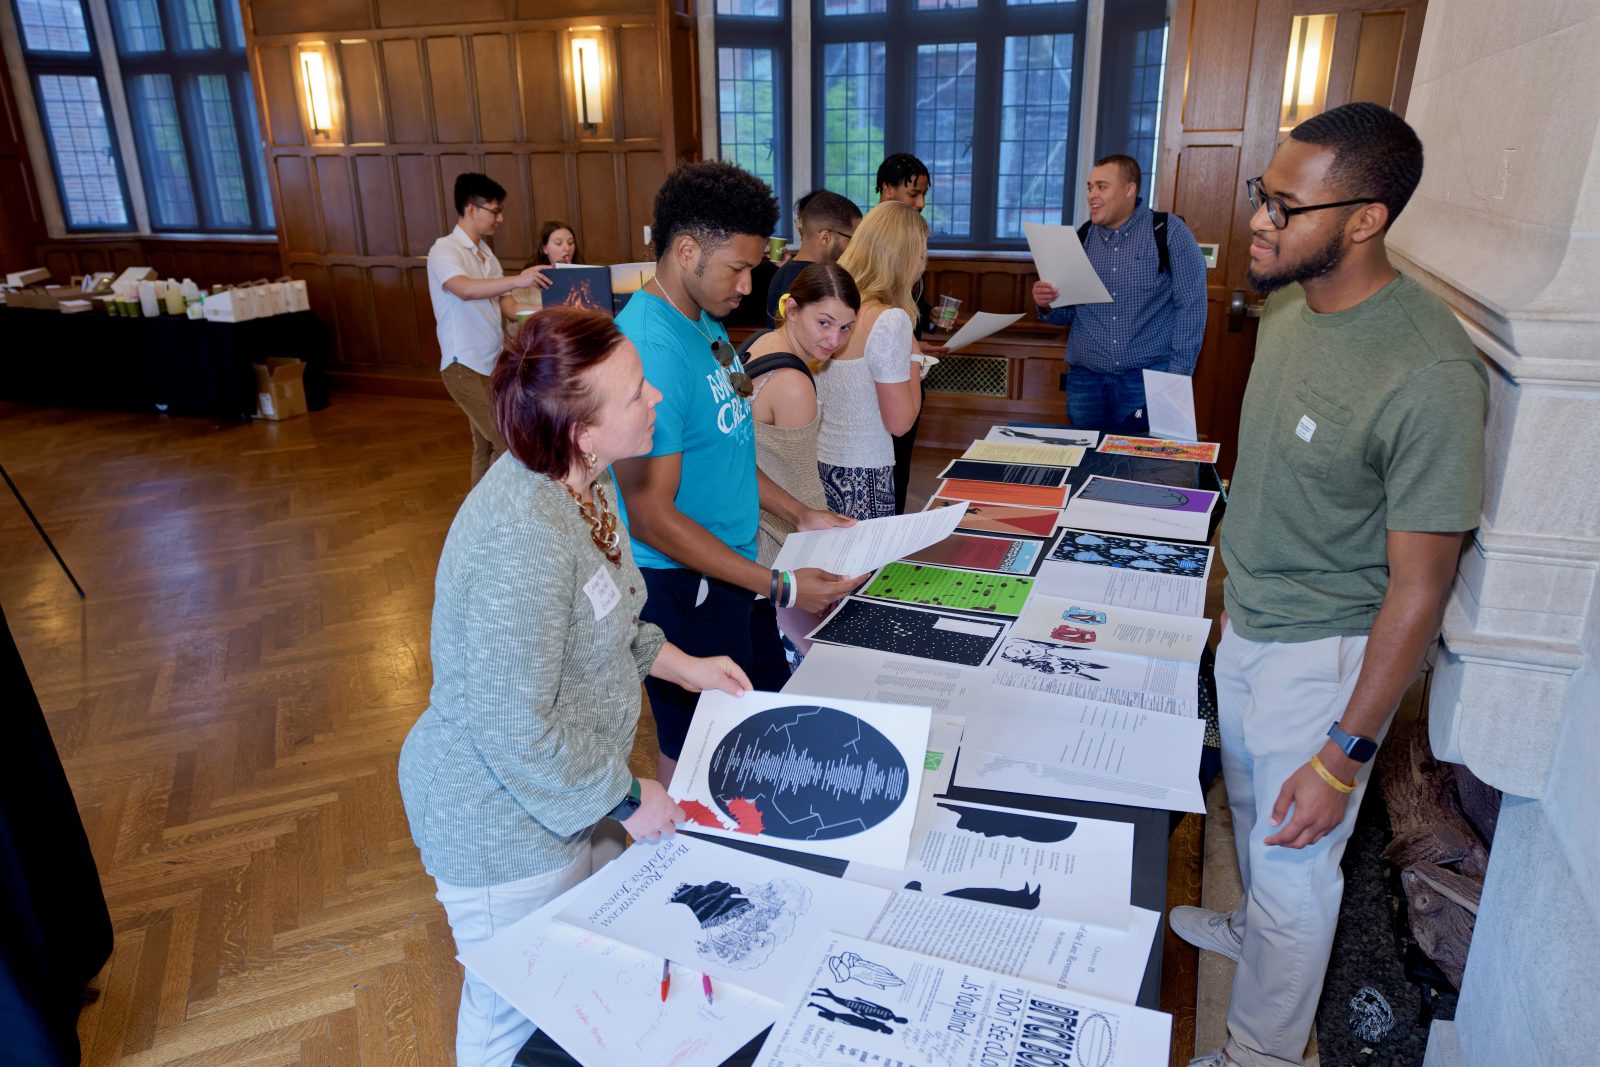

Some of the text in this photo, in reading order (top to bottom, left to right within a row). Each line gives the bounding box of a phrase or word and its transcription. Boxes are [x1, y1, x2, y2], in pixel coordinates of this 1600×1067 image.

[601, 844, 689, 927] BLACK ROMANTICISM
[588, 881, 632, 924] JOHNSON
[1070, 941, 1083, 955] Late
[1075, 931, 1086, 942] the
[815, 966, 824, 977] the
[1059, 955, 1078, 984] Reverend
[807, 976, 818, 990] only
[792, 990, 811, 1020] difference
[955, 992, 982, 1010] You
[947, 1008, 977, 1036] Blind
